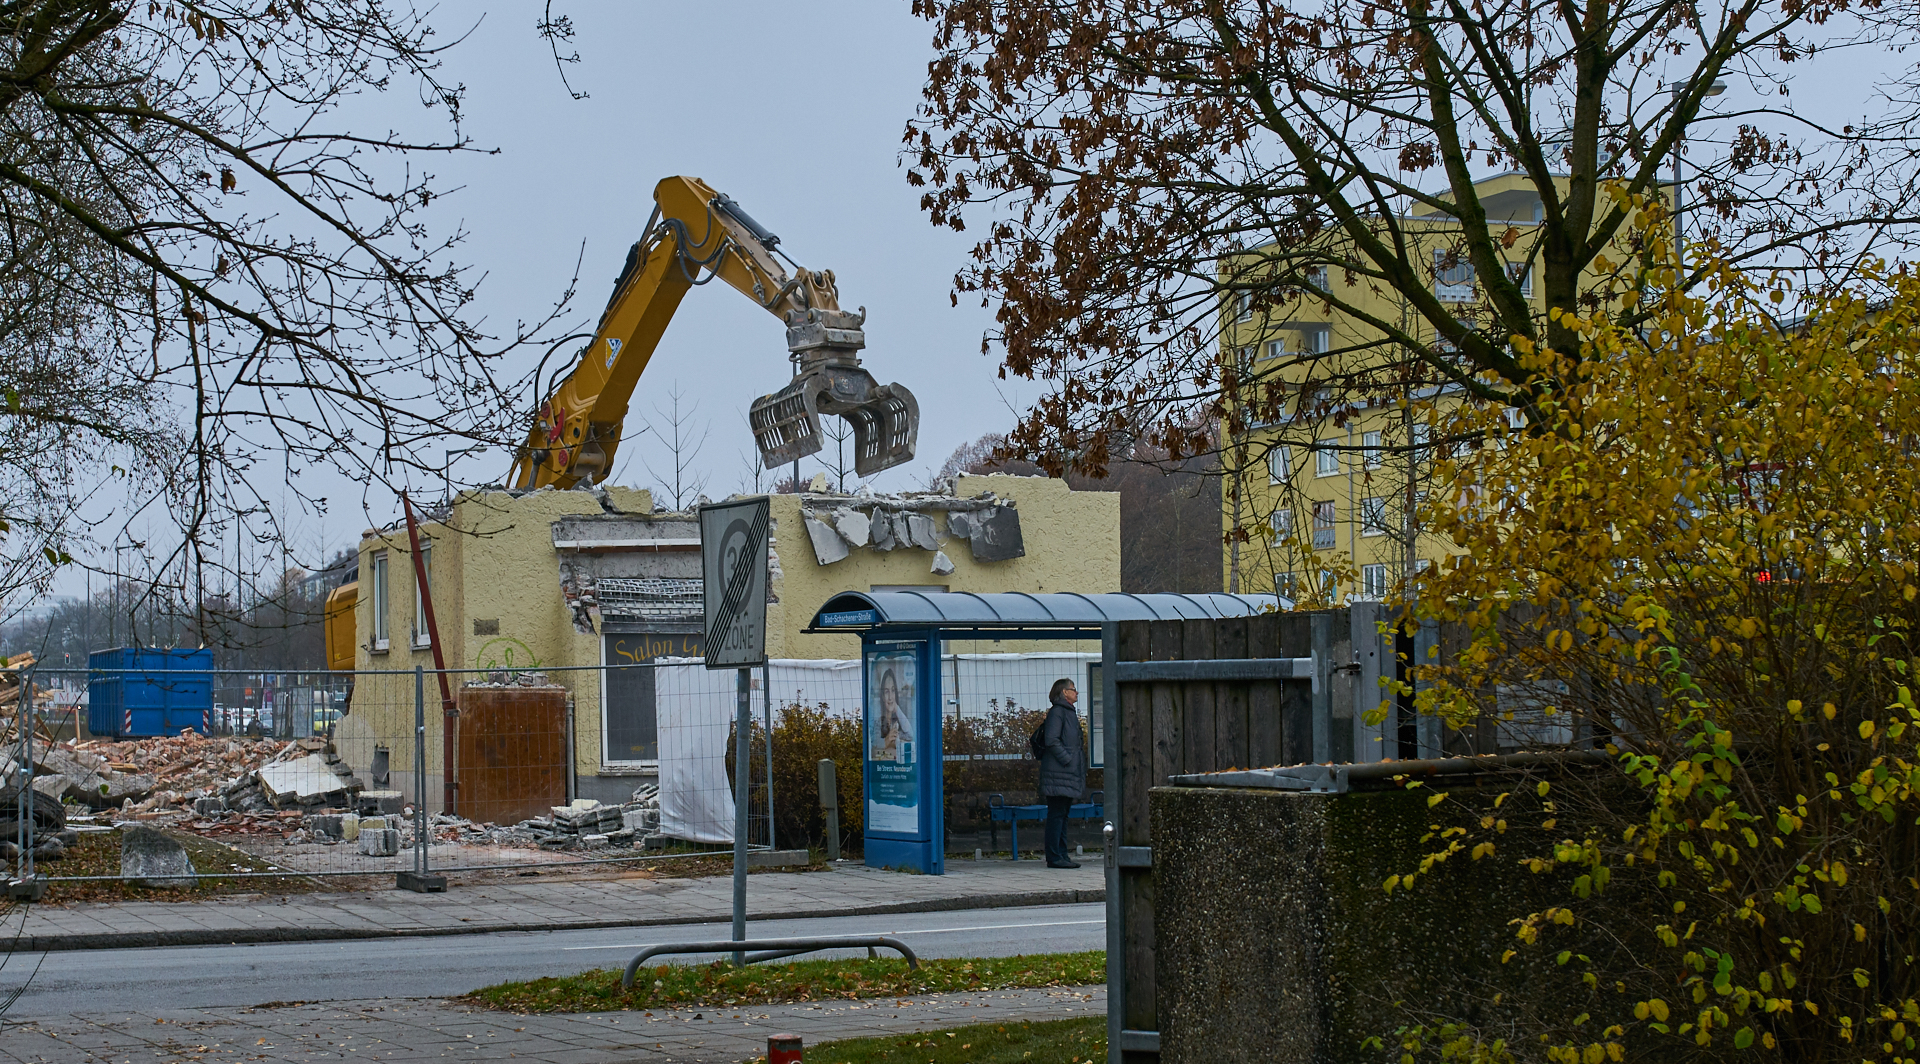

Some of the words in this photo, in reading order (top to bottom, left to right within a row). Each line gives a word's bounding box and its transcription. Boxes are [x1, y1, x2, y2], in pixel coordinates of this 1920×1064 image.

[824, 611, 872, 624] Bad-Schachener-Straße
[724, 624, 754, 651] ZONE
[614, 633, 675, 670] Salon
